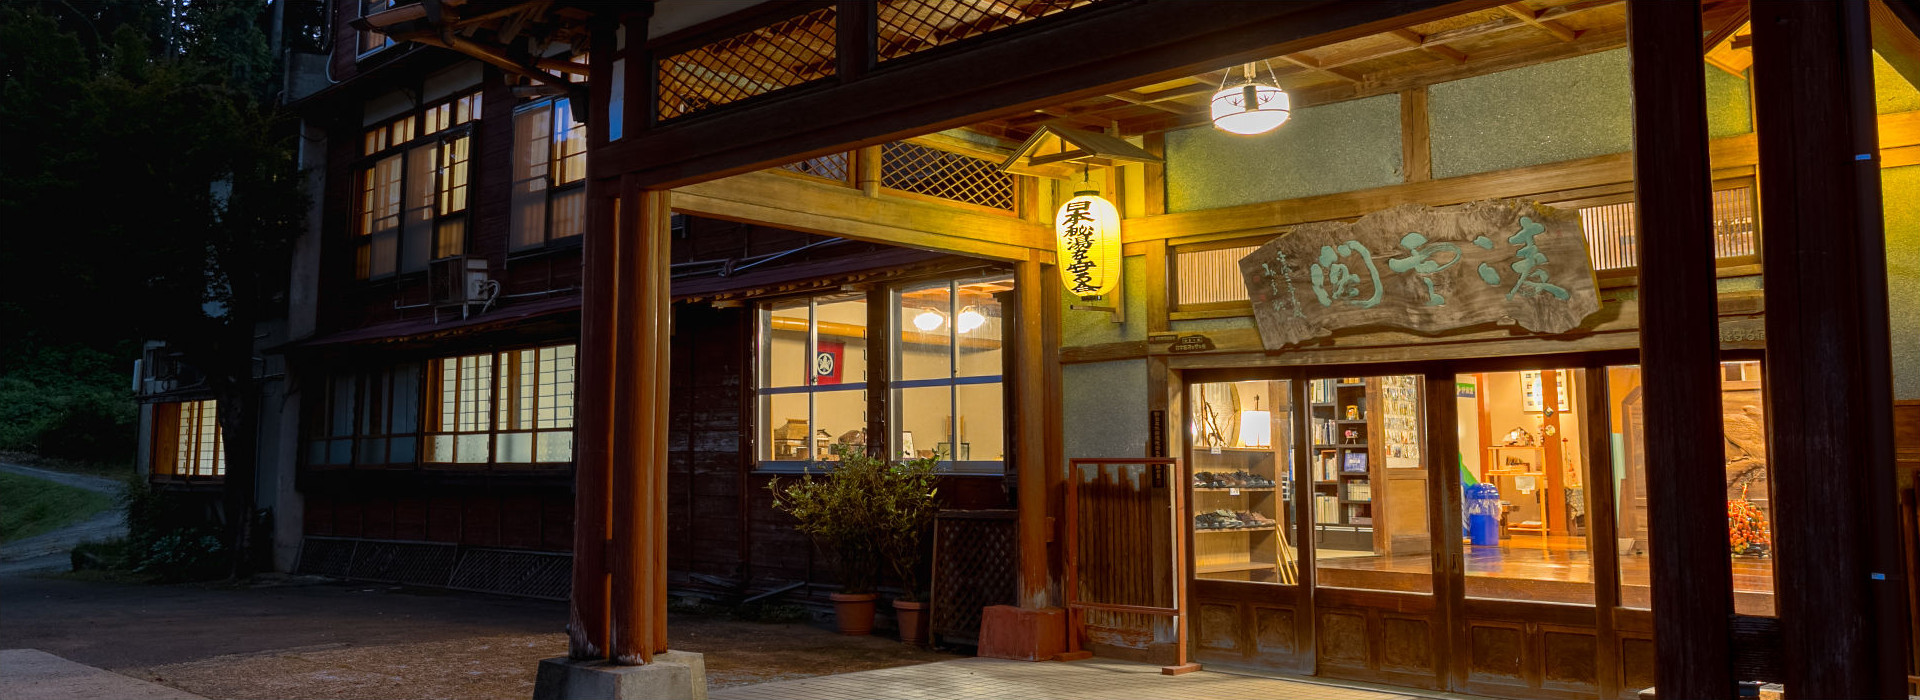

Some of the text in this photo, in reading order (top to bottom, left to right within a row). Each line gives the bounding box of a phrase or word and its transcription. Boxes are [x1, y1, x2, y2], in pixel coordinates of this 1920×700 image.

[1062, 200, 1103, 293] 日本秘湯を守る会
